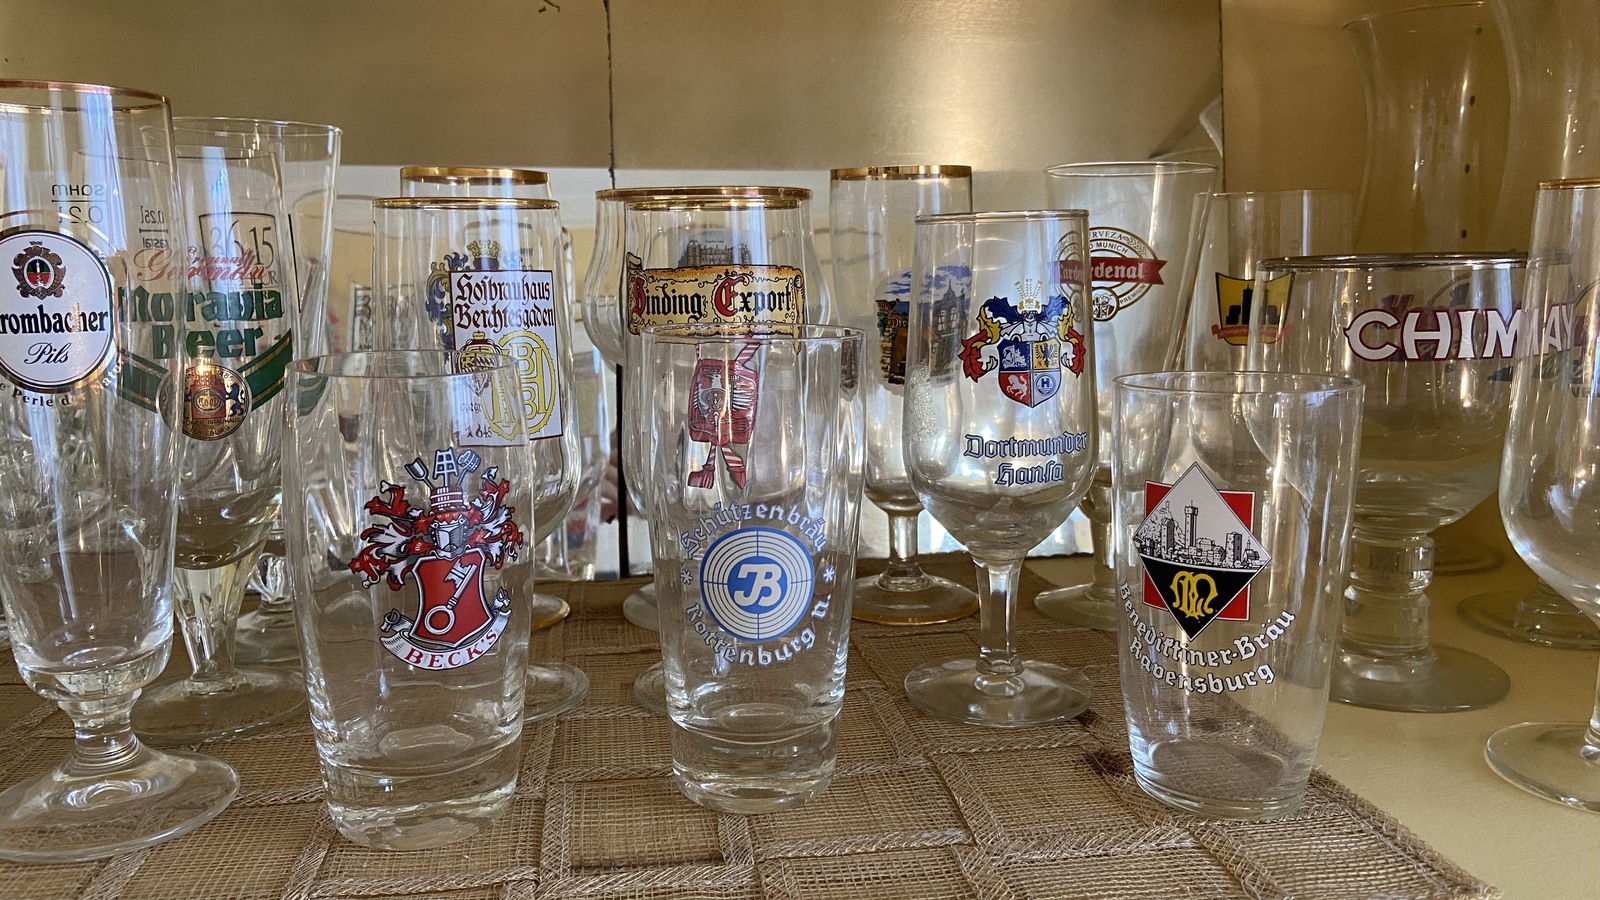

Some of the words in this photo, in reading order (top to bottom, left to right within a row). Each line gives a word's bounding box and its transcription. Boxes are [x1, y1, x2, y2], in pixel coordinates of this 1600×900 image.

[1095, 241, 1129, 255] MUNICH
[632, 277, 704, 323] Binding
[713, 275, 792, 318] Export
[1119, 283, 1148, 305] PREMIUM
[0, 303, 109, 335] rombacher
[454, 300, 555, 334] Berchtesgaden
[1343, 303, 1575, 362] CHIMAY
[24, 342, 72, 364] Pils
[151, 323, 264, 361] Beer
[12, 387, 54, 407] Perle
[963, 430, 1088, 459] Dortmunder
[680, 501, 828, 561] Schützenbräu
[1119, 580, 1296, 667] Benediktiner-Bräu
[403, 631, 498, 669] BECK'S
[1129, 636, 1276, 695] Ravensburg
